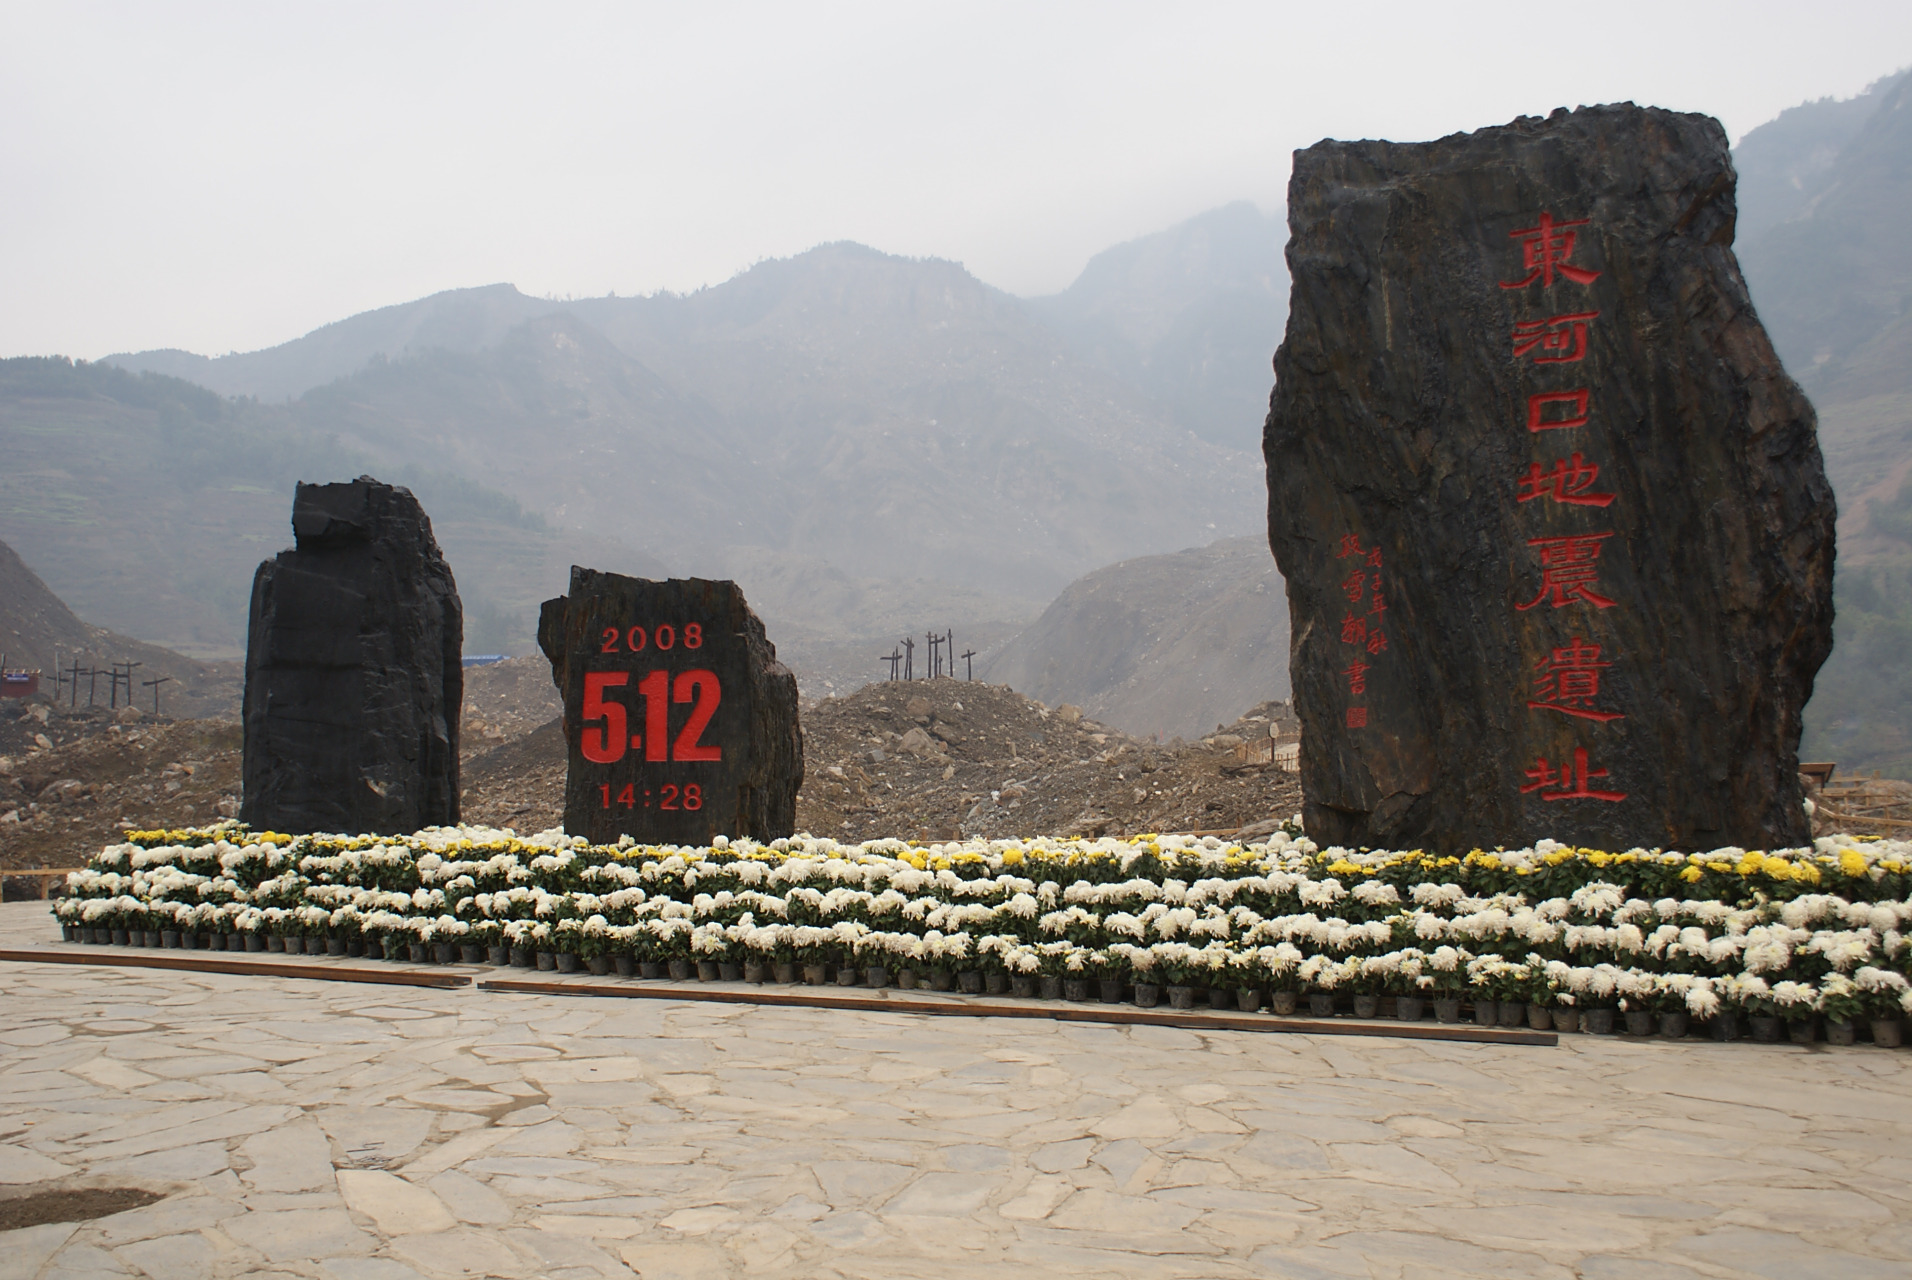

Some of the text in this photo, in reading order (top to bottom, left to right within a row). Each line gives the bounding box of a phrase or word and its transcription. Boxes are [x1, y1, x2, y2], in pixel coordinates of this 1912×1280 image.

[1498, 211, 1628, 803] 東河口地震遺址
[601, 621, 703, 653] 2008
[580, 668, 722, 764] 5.12
[599, 782, 703, 811] 14:28
